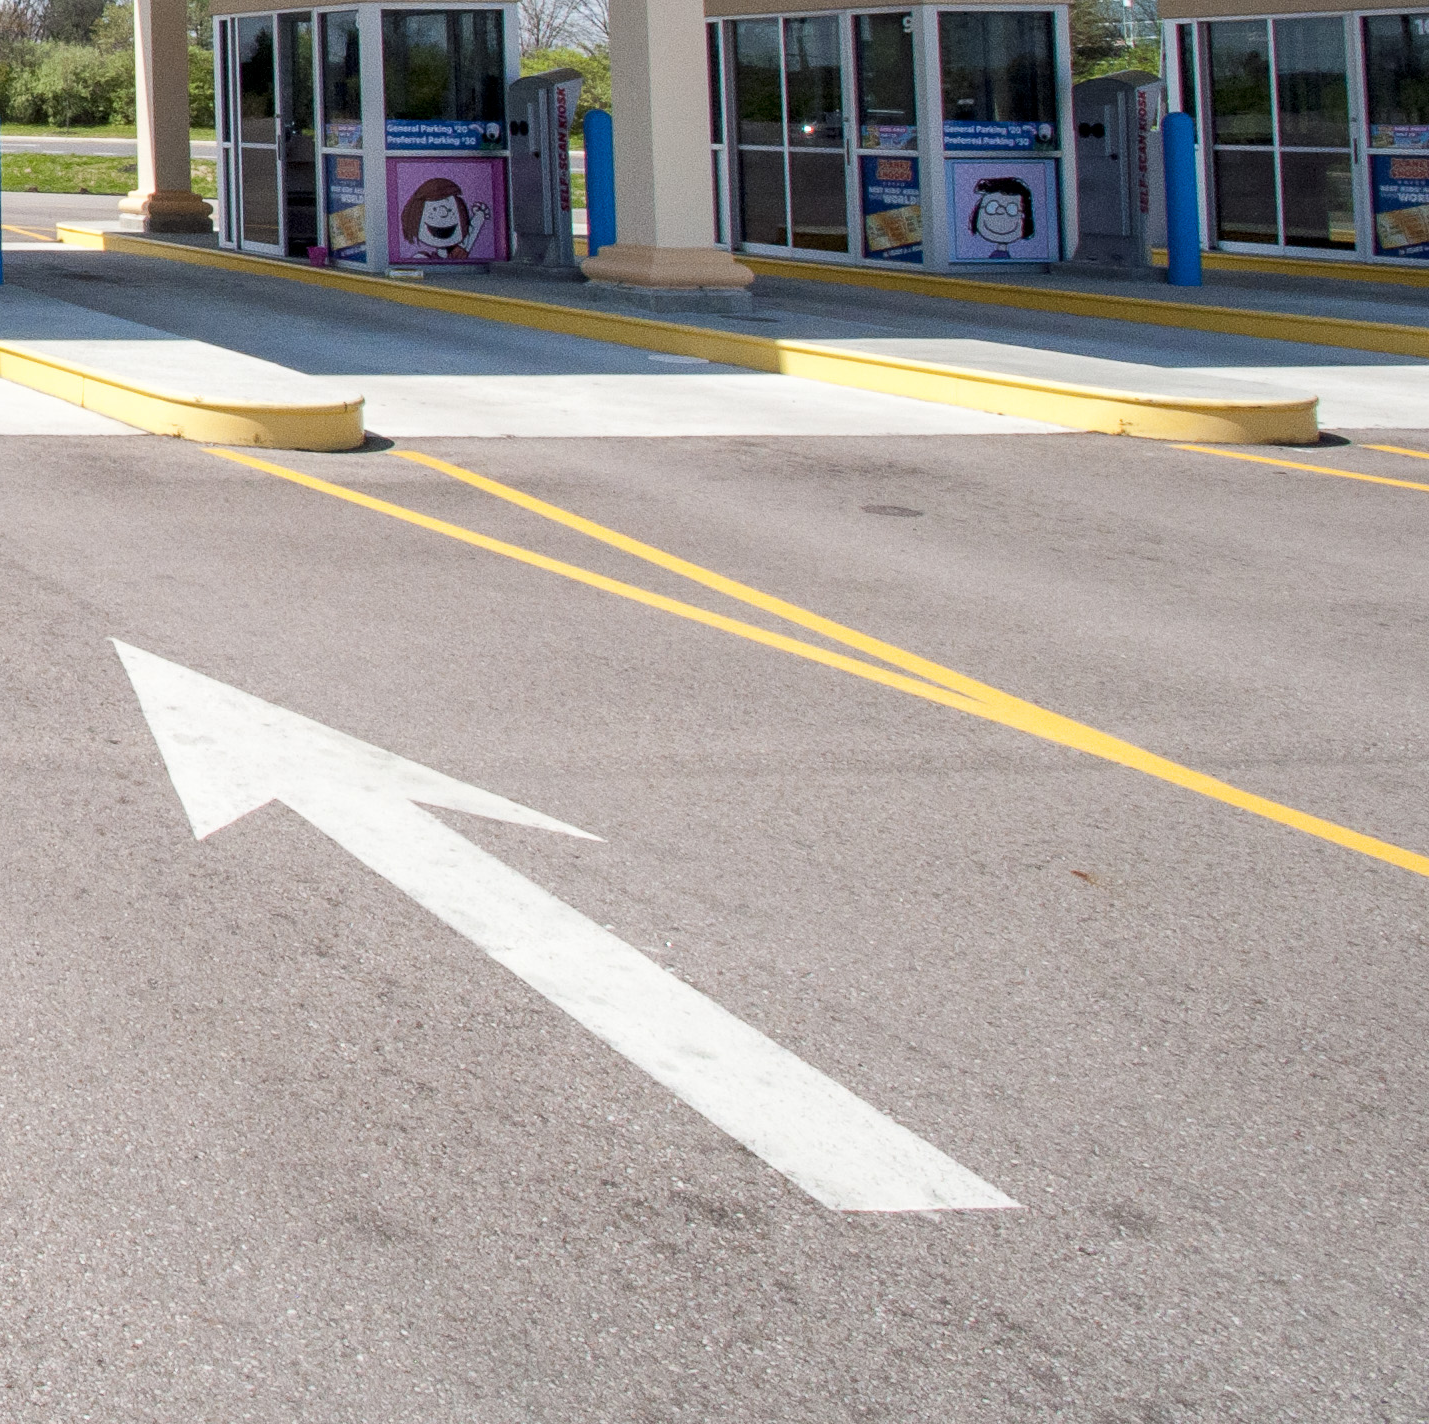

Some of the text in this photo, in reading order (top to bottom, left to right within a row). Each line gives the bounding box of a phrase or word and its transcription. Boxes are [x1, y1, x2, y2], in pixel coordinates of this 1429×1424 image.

[902, 16, 913, 33] 9
[387, 125, 468, 135] General Parking $20
[944, 126, 974, 134] General
[976, 126, 1007, 136] Parking
[387, 136, 427, 145] Preferred
[429, 136, 460, 146] Parking
[944, 137, 981, 145] Preferred
[983, 138, 1014, 147] Parking
[556, 87, 570, 212] SELF-SCAN KIOSK
[1138, 91, 1149, 213] SELF-SCAN KIOSK
